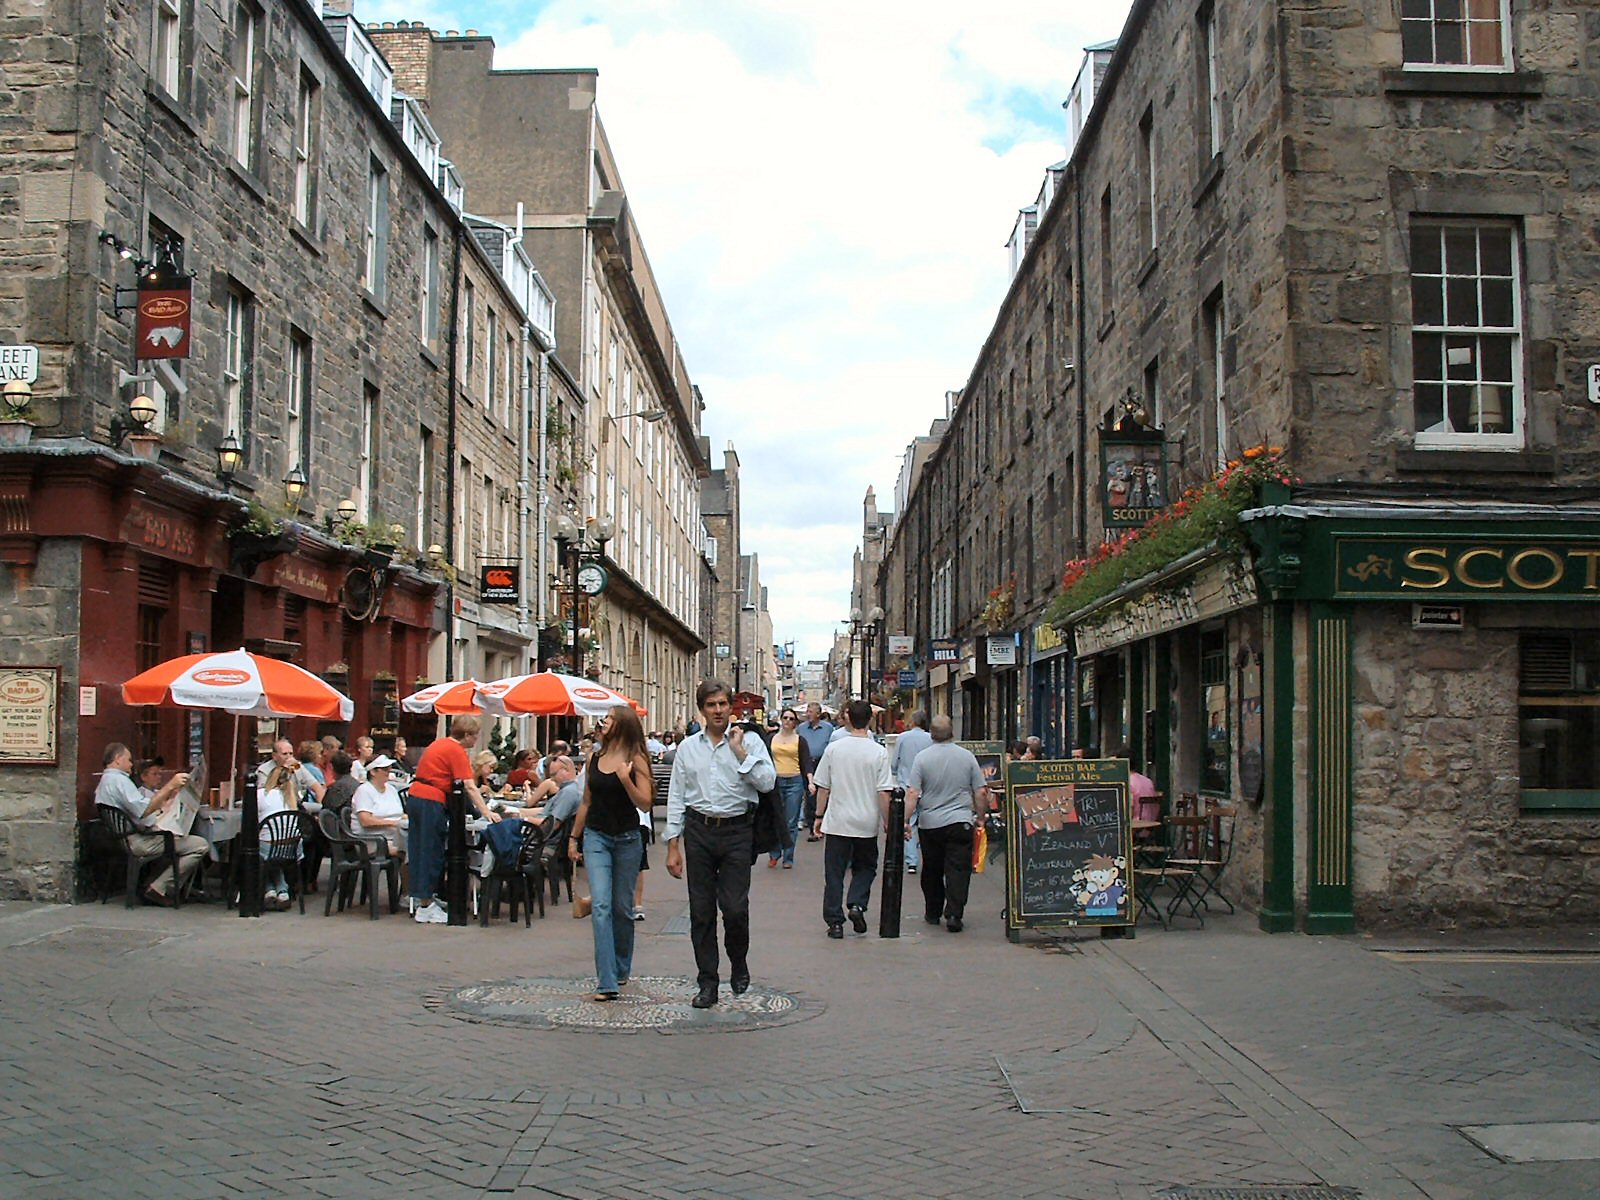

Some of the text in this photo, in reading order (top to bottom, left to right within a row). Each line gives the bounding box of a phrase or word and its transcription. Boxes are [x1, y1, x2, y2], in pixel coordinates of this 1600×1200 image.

[2, 349, 31, 363] EET
[933, 649, 957, 661] HILL
[1039, 763, 1097, 773] SCOTTS BAR
[1036, 772, 1101, 783] Festival Ales
